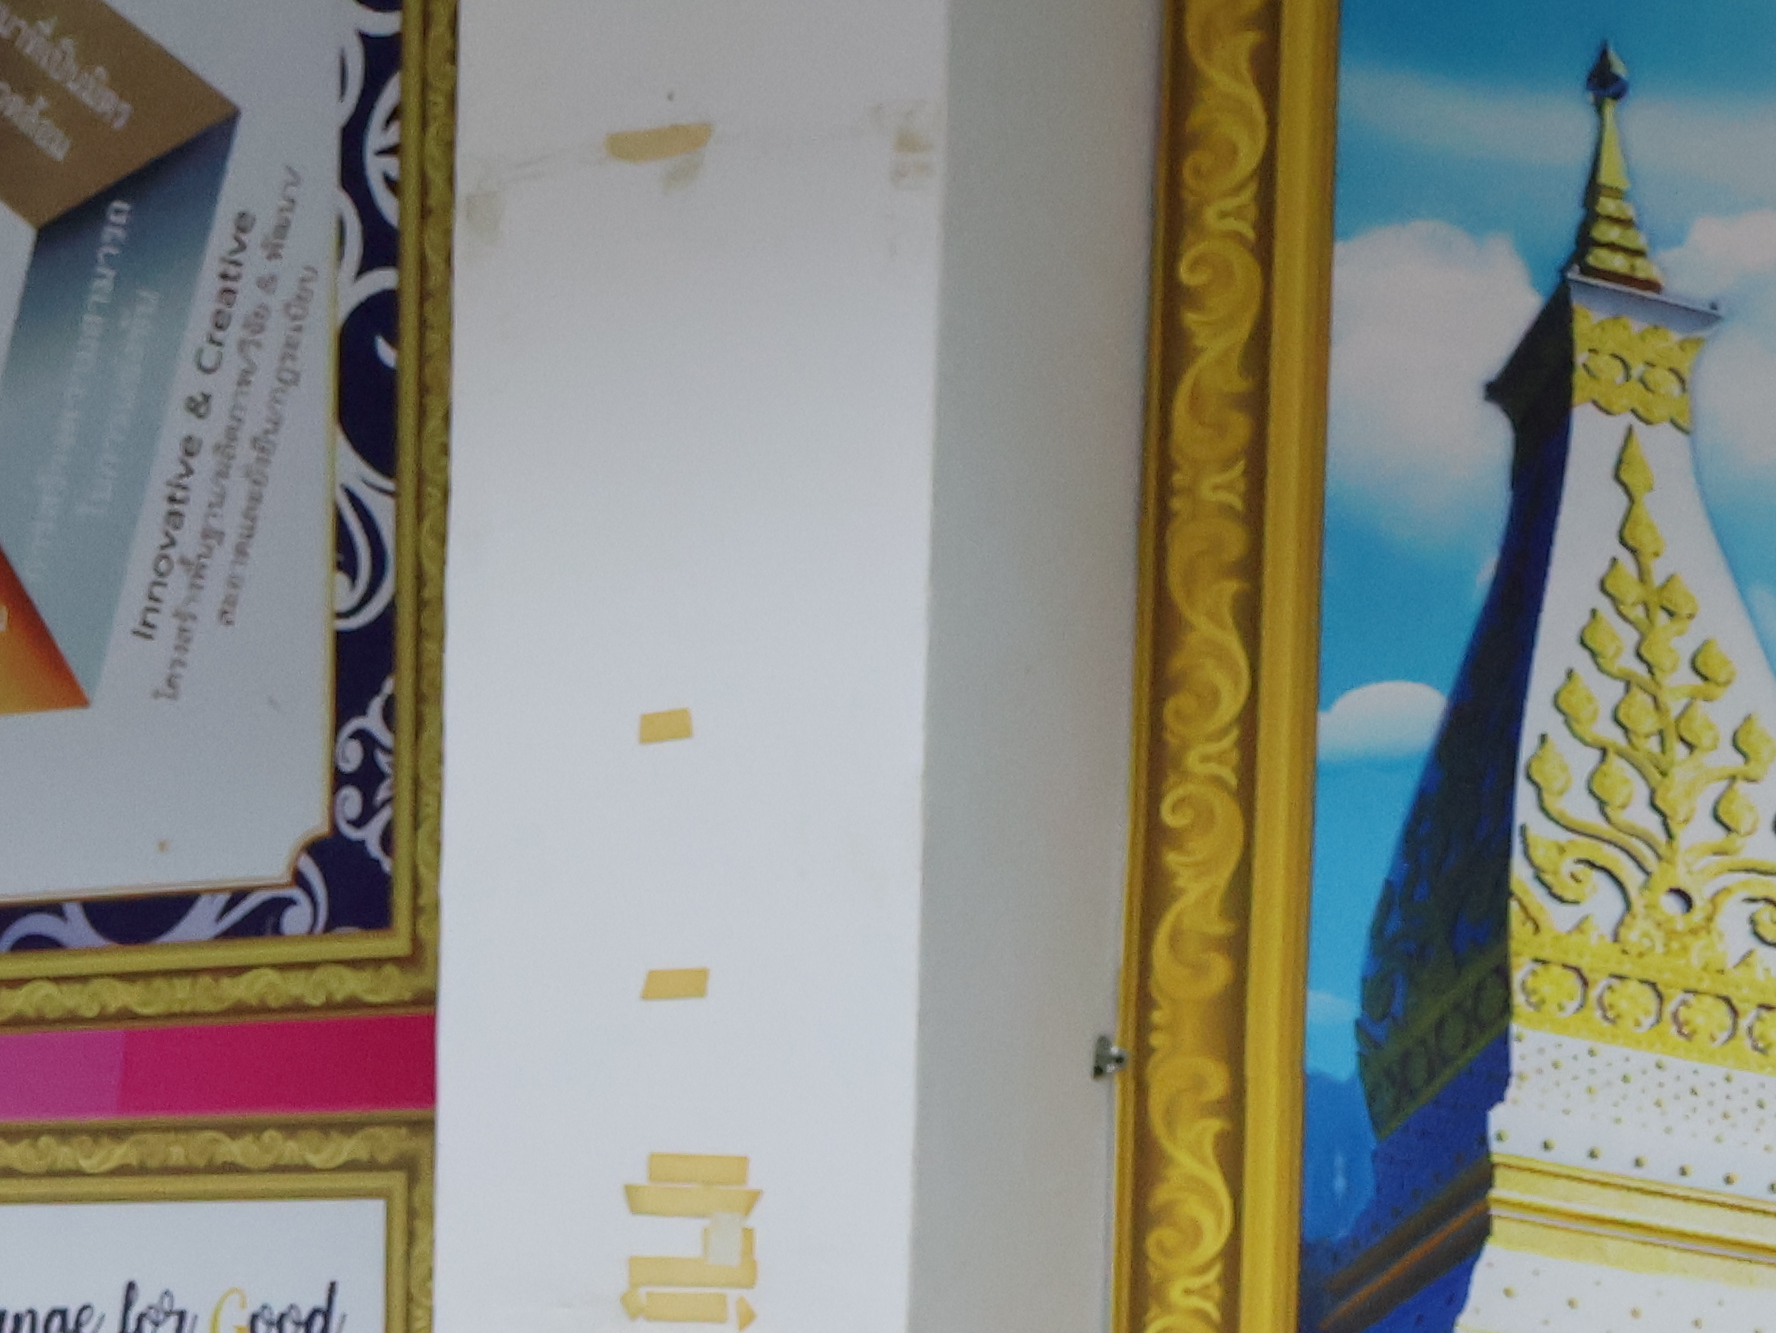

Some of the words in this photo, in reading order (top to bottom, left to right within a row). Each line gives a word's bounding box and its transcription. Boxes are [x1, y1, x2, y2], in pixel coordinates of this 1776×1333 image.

[133, 428, 200, 643] Innovative
[184, 388, 211, 418] &
[198, 208, 255, 376] Creative
